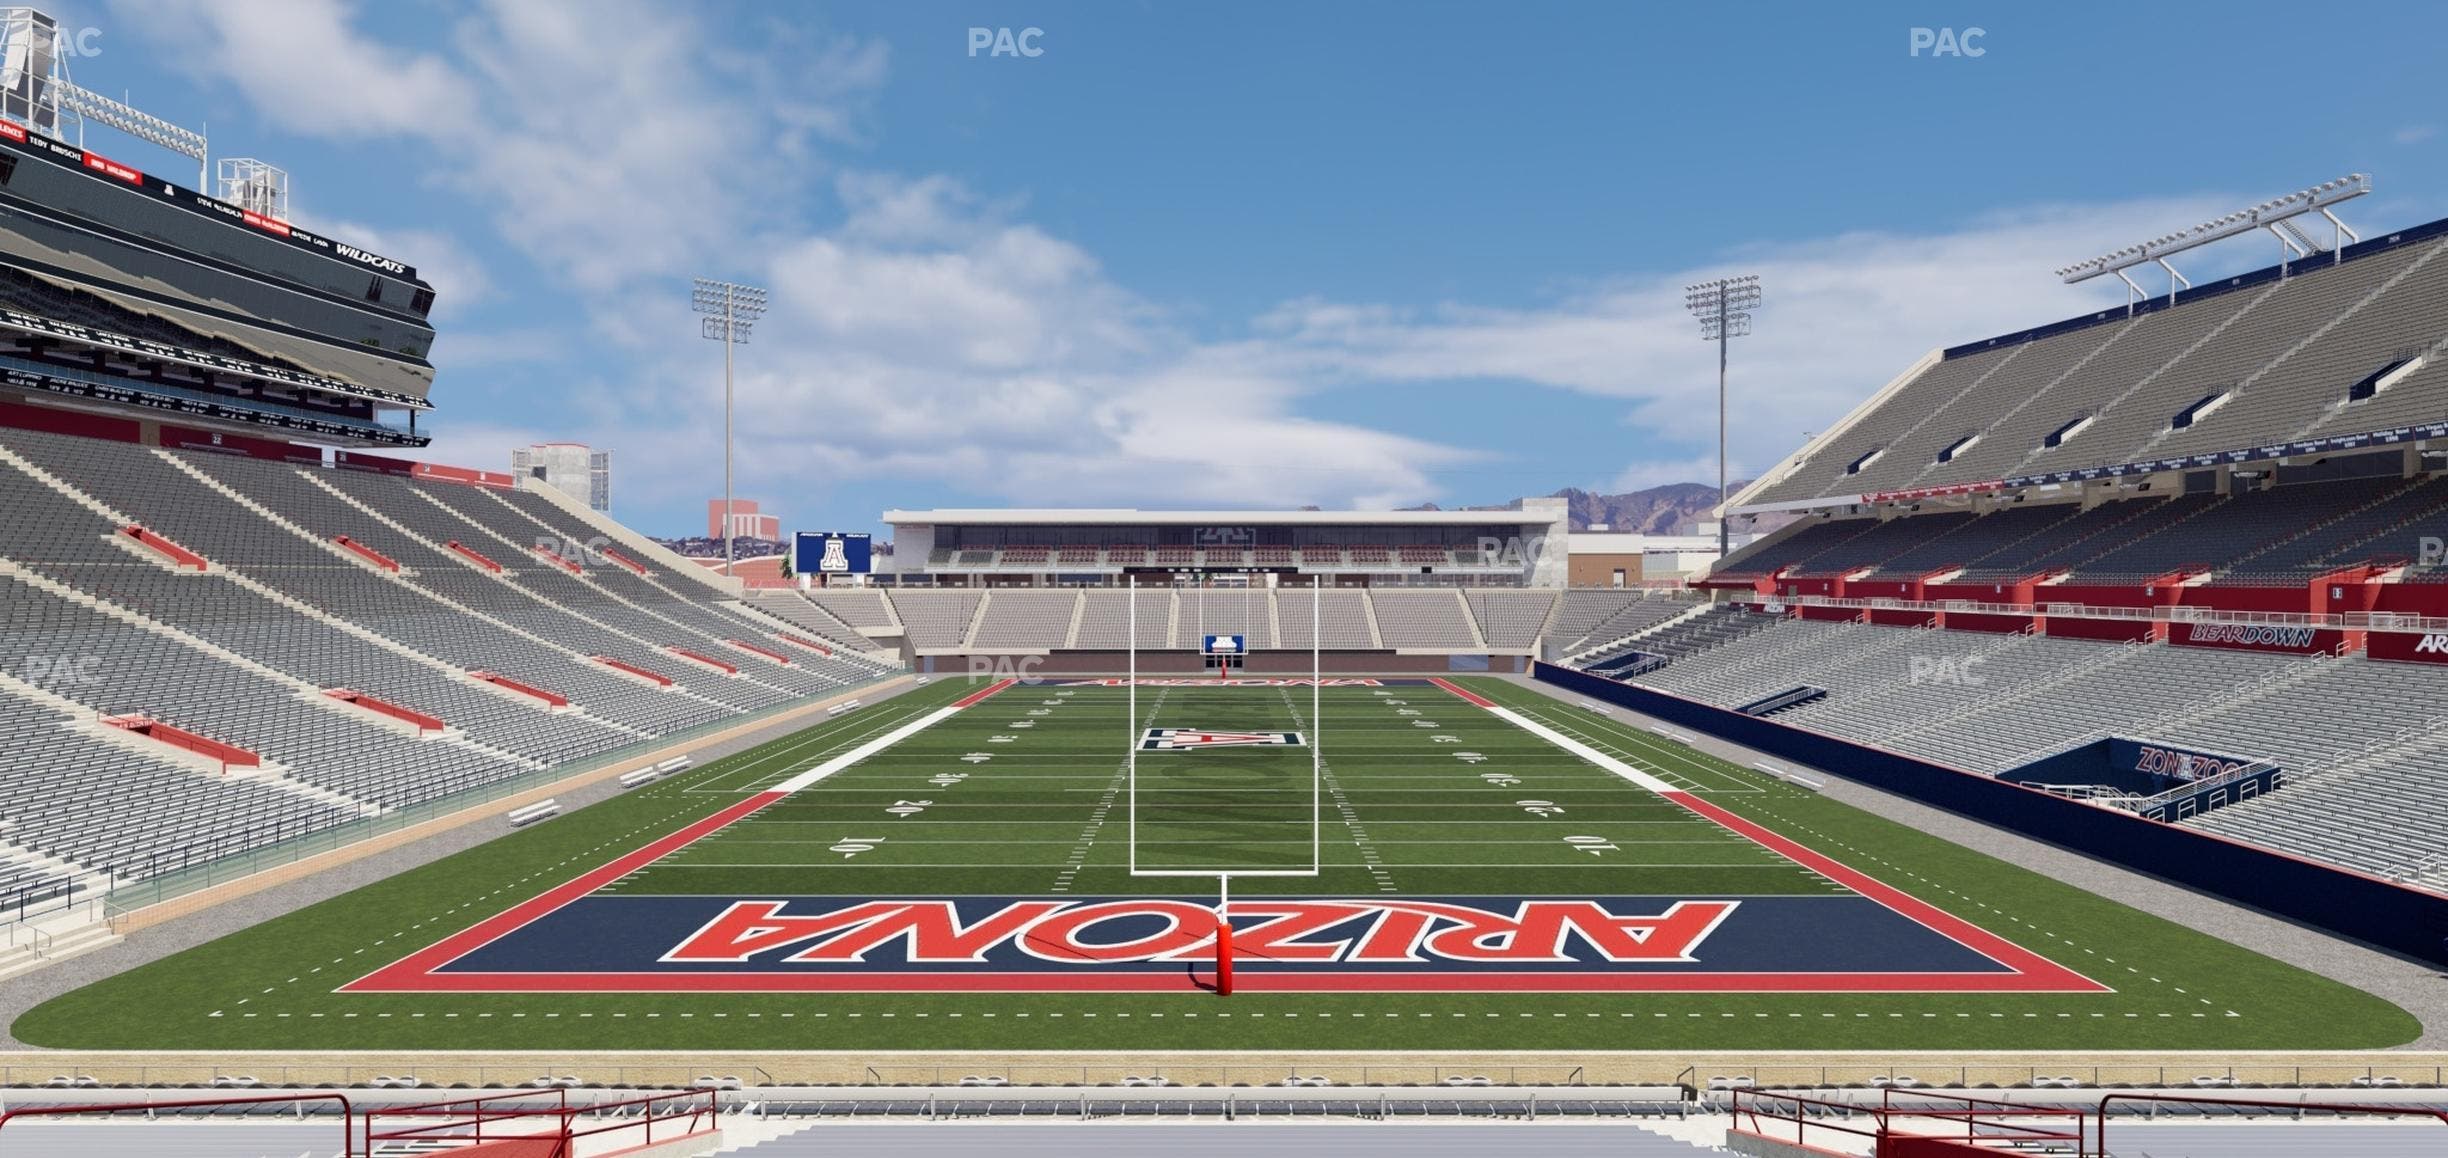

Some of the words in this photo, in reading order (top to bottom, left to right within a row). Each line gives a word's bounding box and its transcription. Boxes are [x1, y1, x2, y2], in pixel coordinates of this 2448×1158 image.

[336, 243, 405, 274] WILDCATS
[820, 539, 848, 571] A
[885, 800, 933, 814] 20
[1516, 800, 1566, 814] 20
[829, 837, 886, 853] 10
[1562, 836, 1620, 852] 10
[656, 900, 1743, 964] ARIZONA
